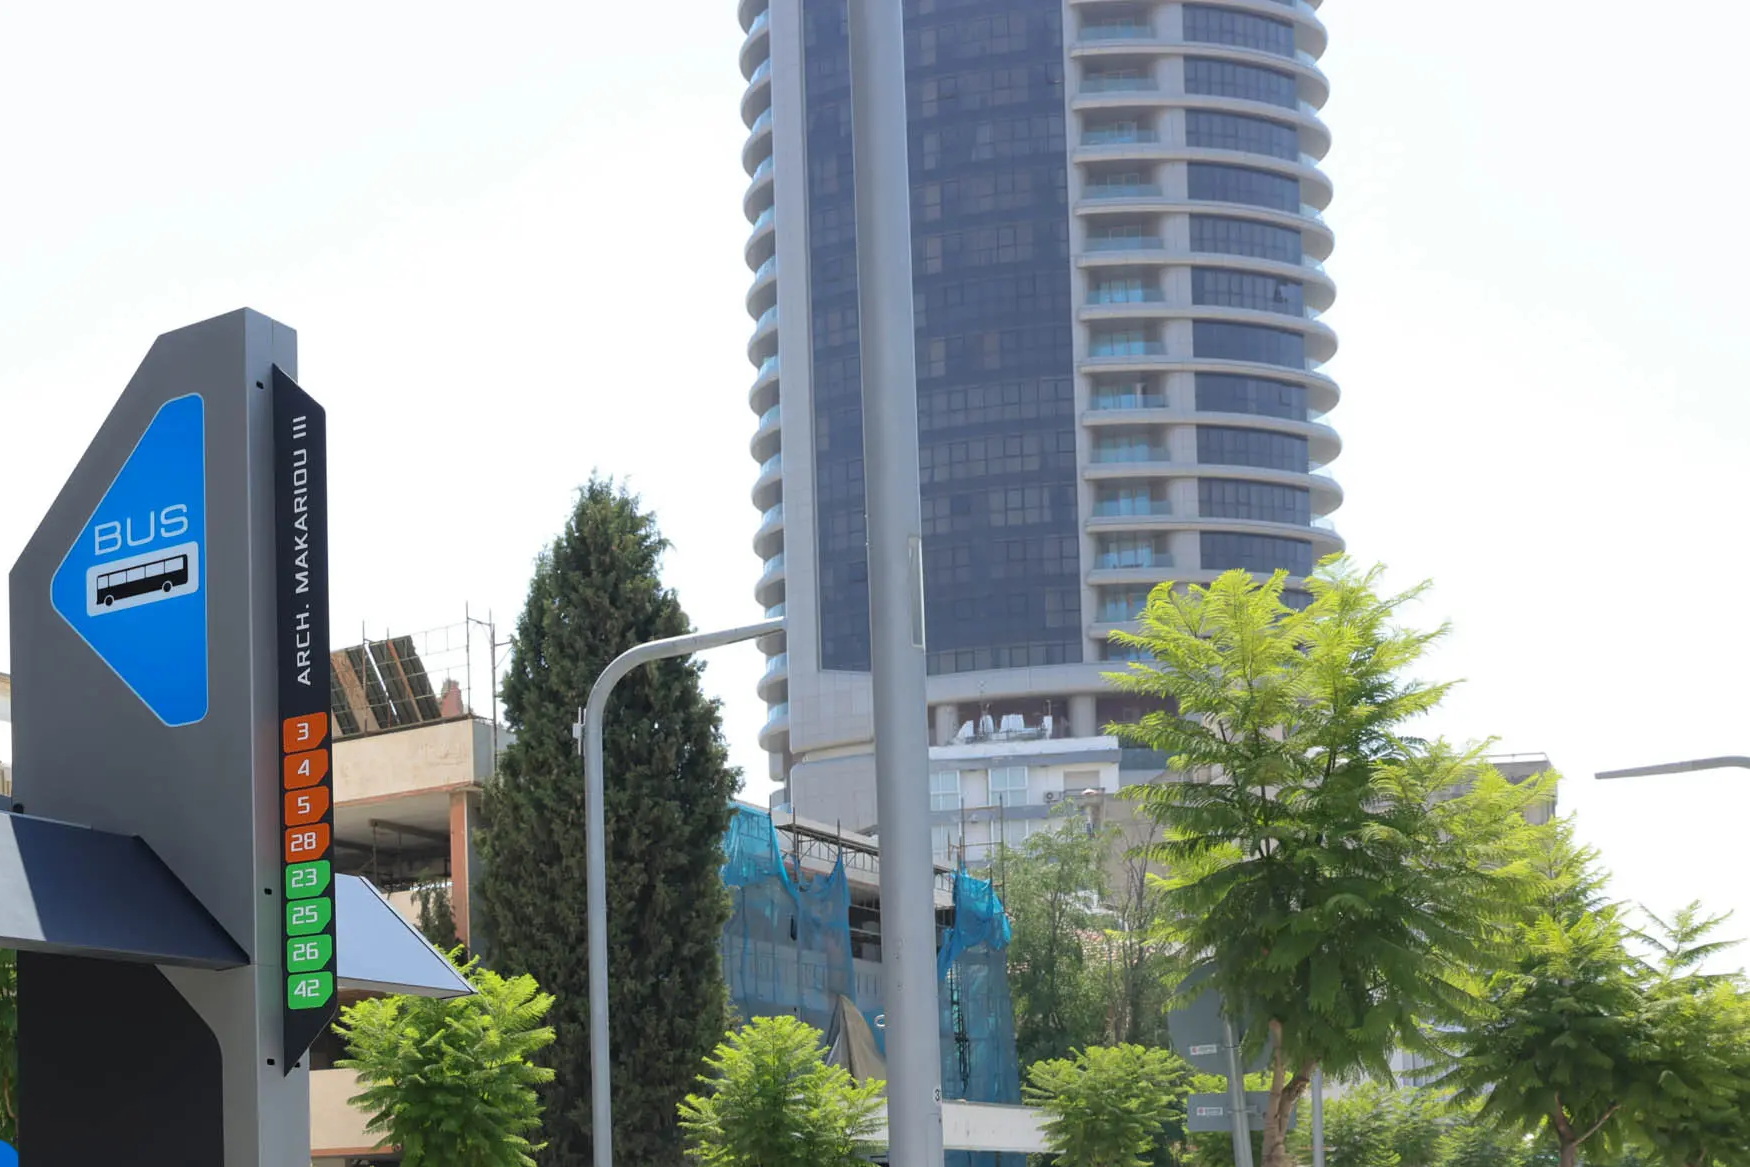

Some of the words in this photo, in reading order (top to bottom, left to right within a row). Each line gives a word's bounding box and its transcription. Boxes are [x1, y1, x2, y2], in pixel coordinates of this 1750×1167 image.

[94, 503, 189, 556] BUS
[293, 448, 310, 594] MAKARIOU
[296, 602, 311, 686] ARCH.
[296, 722, 310, 741] 3
[297, 759, 311, 777] 4
[297, 796, 311, 815] 5
[290, 831, 317, 852] 28
[291, 867, 318, 888] 23
[291, 904, 319, 925] 25
[292, 941, 320, 962] 26
[293, 978, 321, 998] 42
